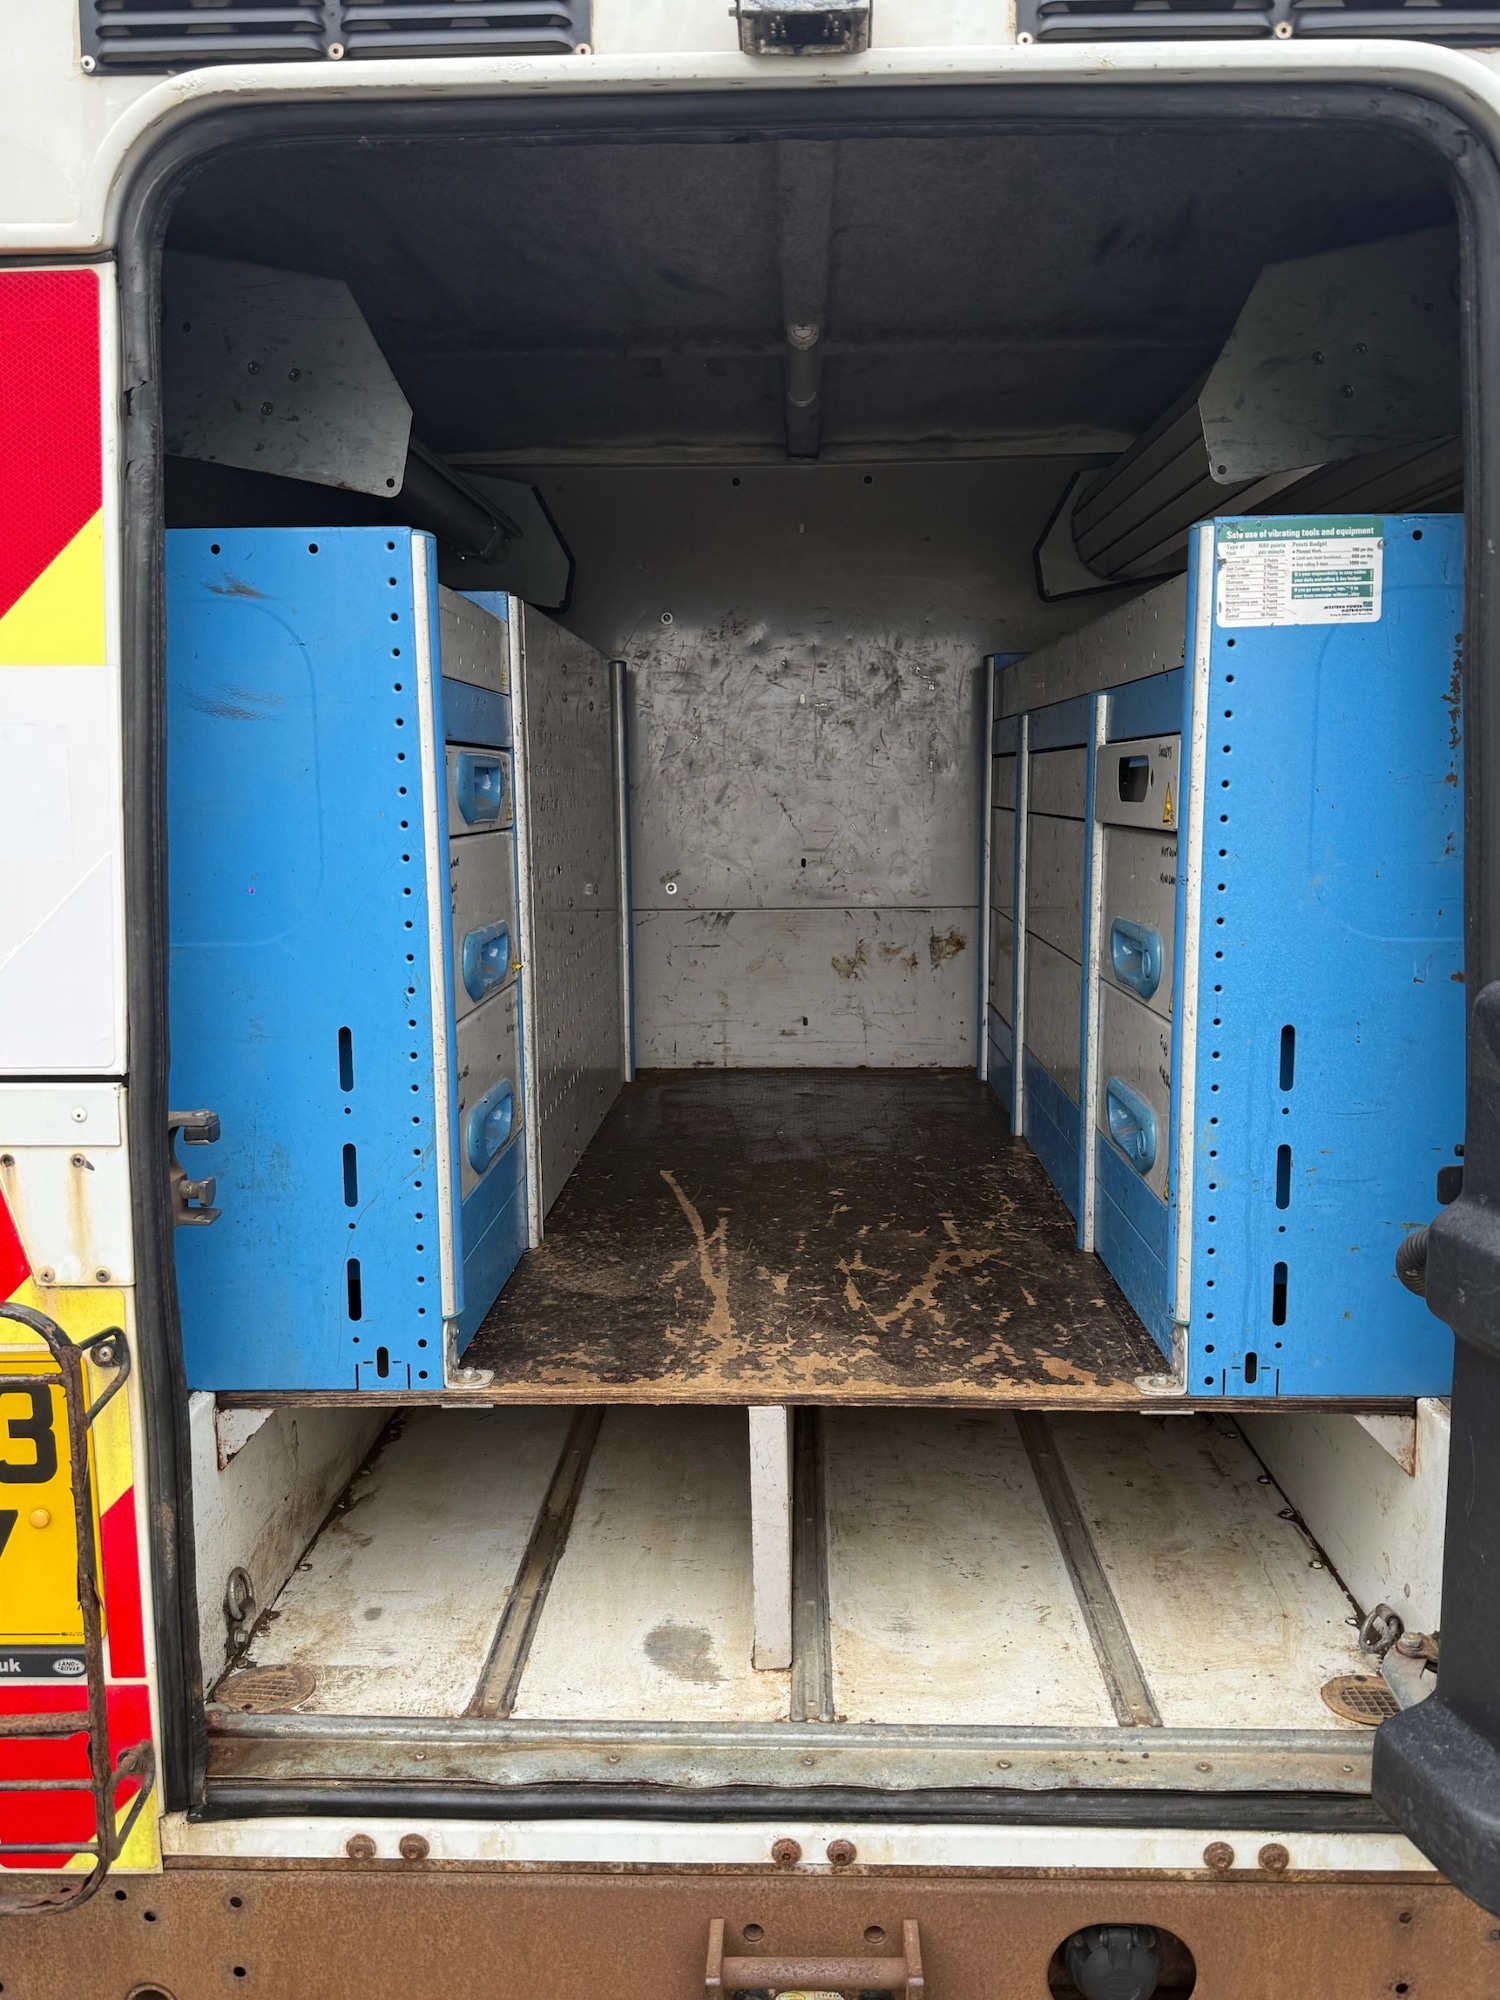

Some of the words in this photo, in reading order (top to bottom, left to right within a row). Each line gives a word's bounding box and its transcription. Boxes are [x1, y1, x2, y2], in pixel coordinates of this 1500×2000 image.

[1226, 530, 1243, 539] Safe
[1259, 530, 1267, 538] of
[1268, 529, 1300, 538] vibrating
[1301, 528, 1320, 536] tools
[1321, 527, 1334, 535] and
[1335, 526, 1374, 537] equipment
